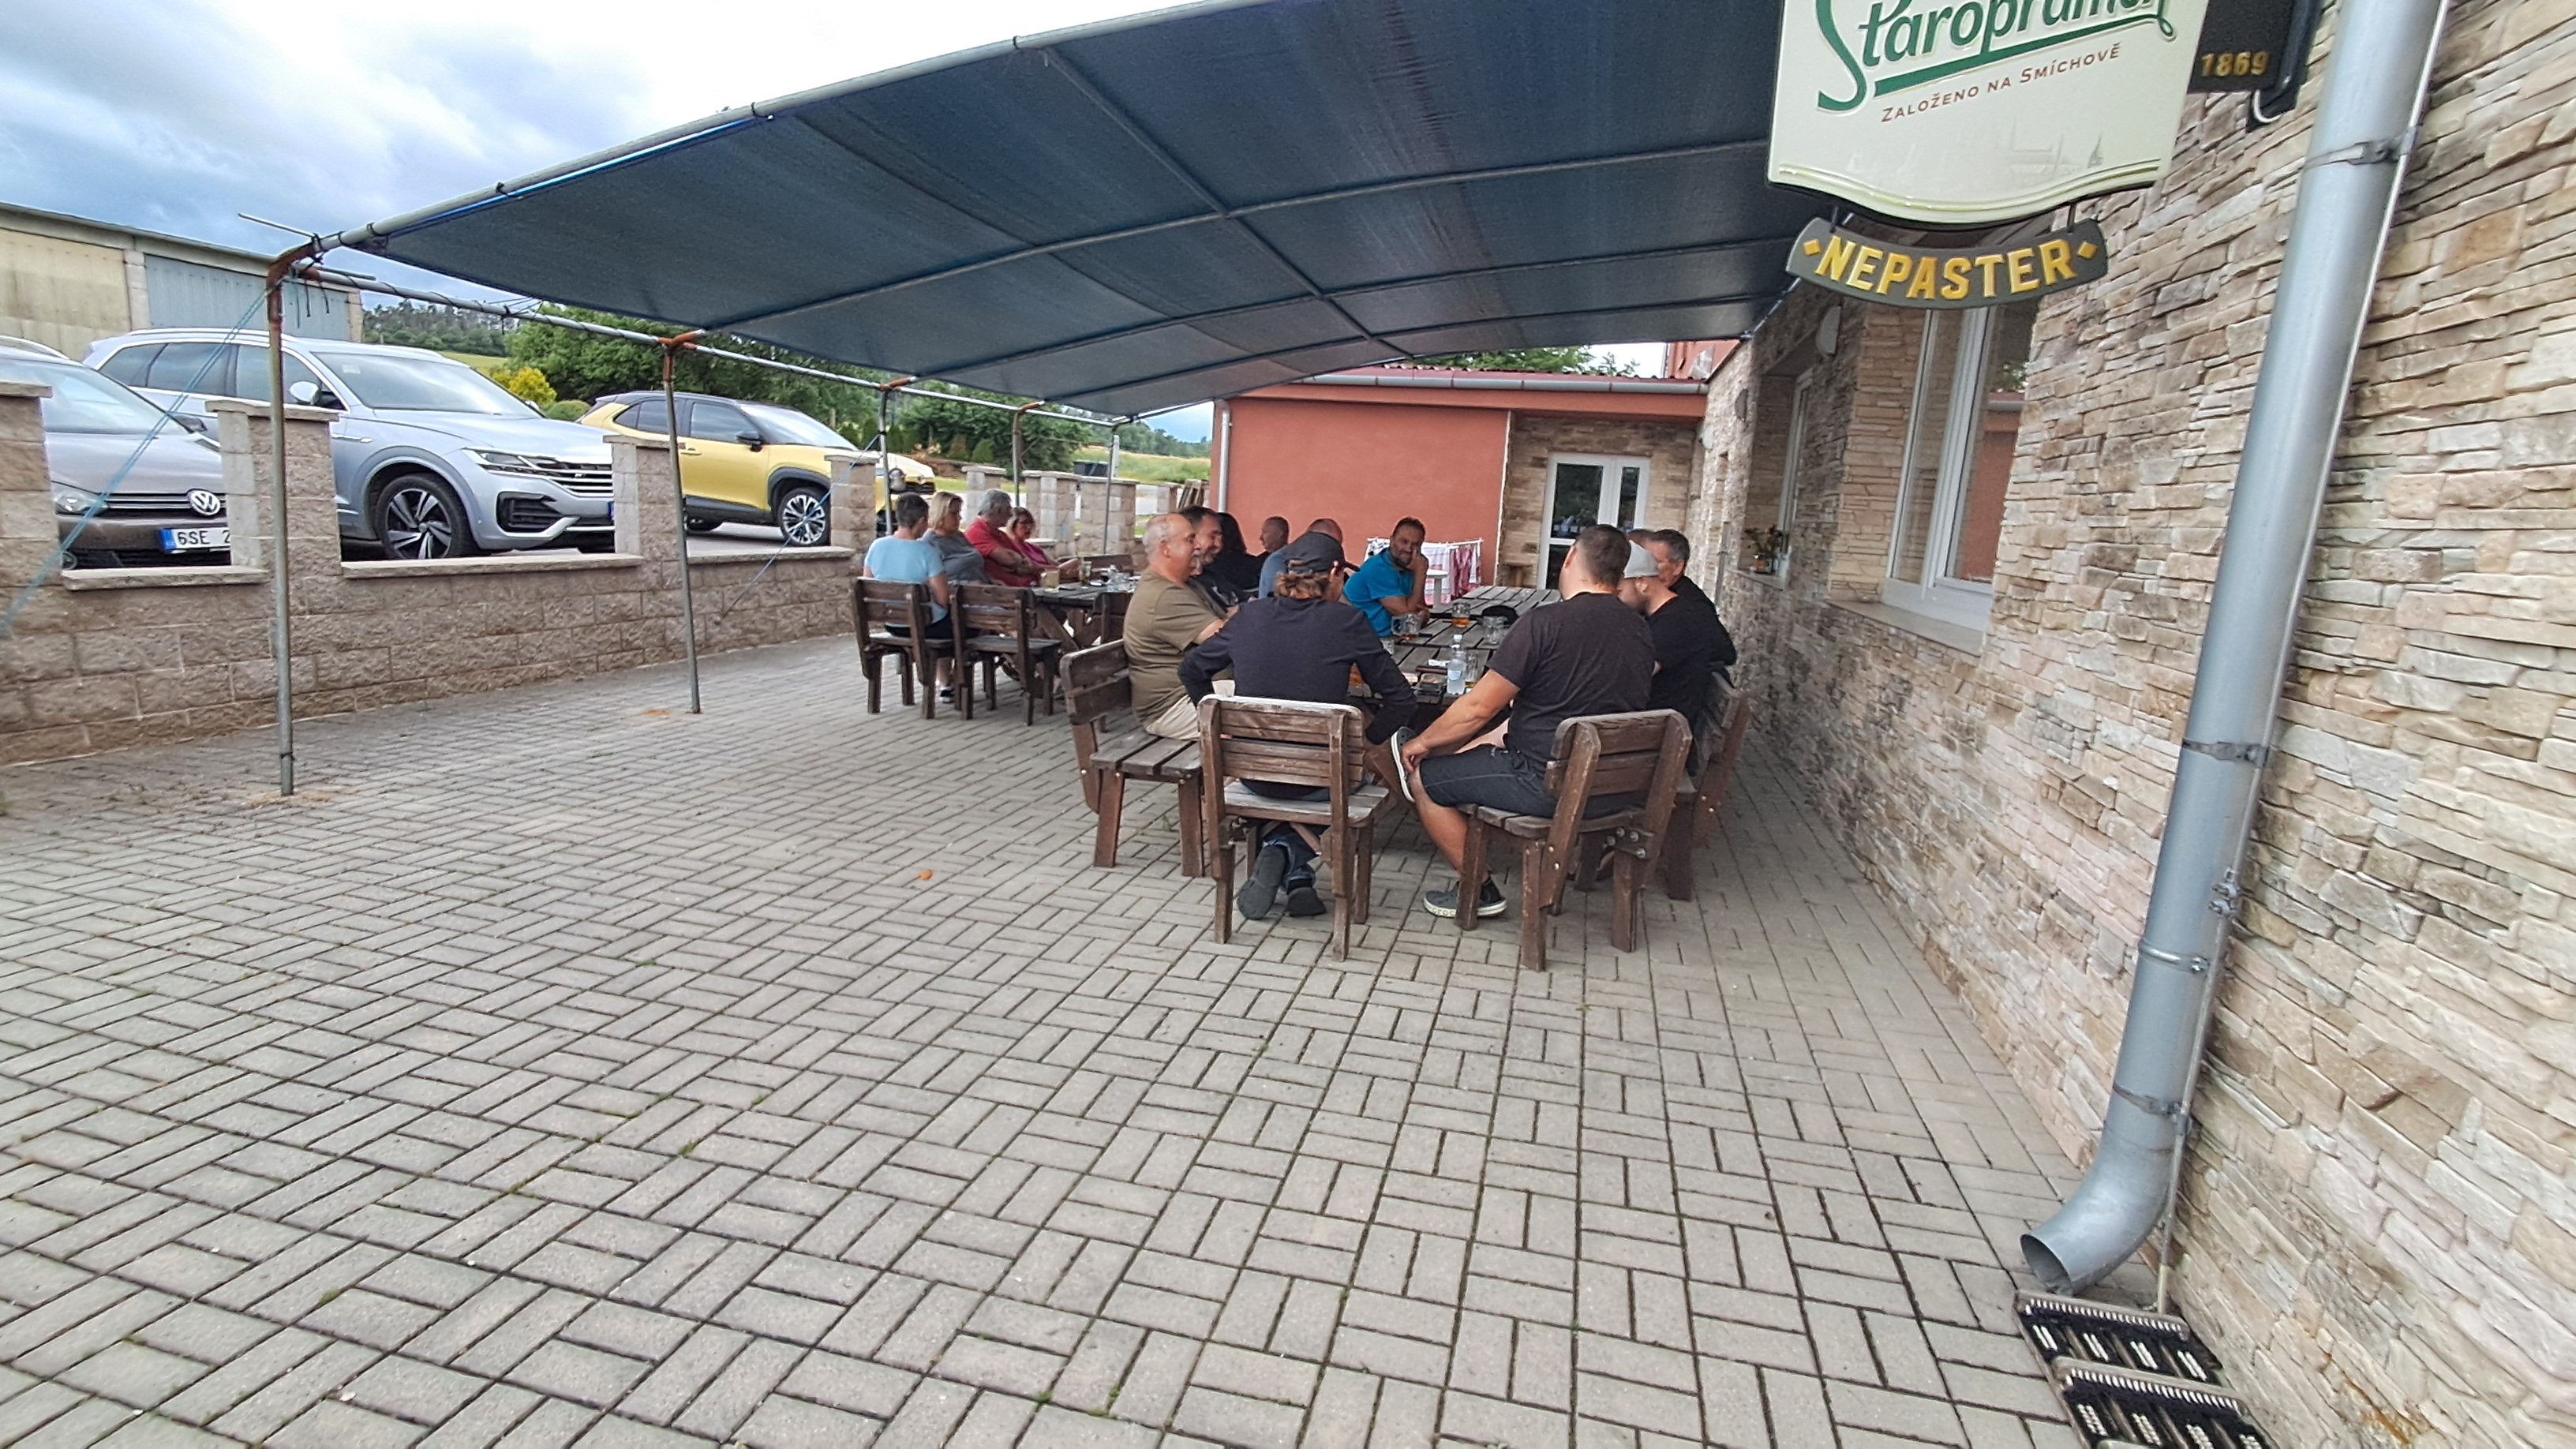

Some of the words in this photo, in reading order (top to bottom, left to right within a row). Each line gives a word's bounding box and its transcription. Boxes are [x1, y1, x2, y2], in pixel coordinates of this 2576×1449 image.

[1881, 86, 1979, 123] ZALOŽENO
[1987, 77, 2012, 93] NA
[2020, 43, 2121, 84] SMÍCHOVĚ
[2201, 51, 2270, 77] 1869
[1814, 235, 2078, 300] NEPASTER
[178, 530, 211, 545] 6SE
